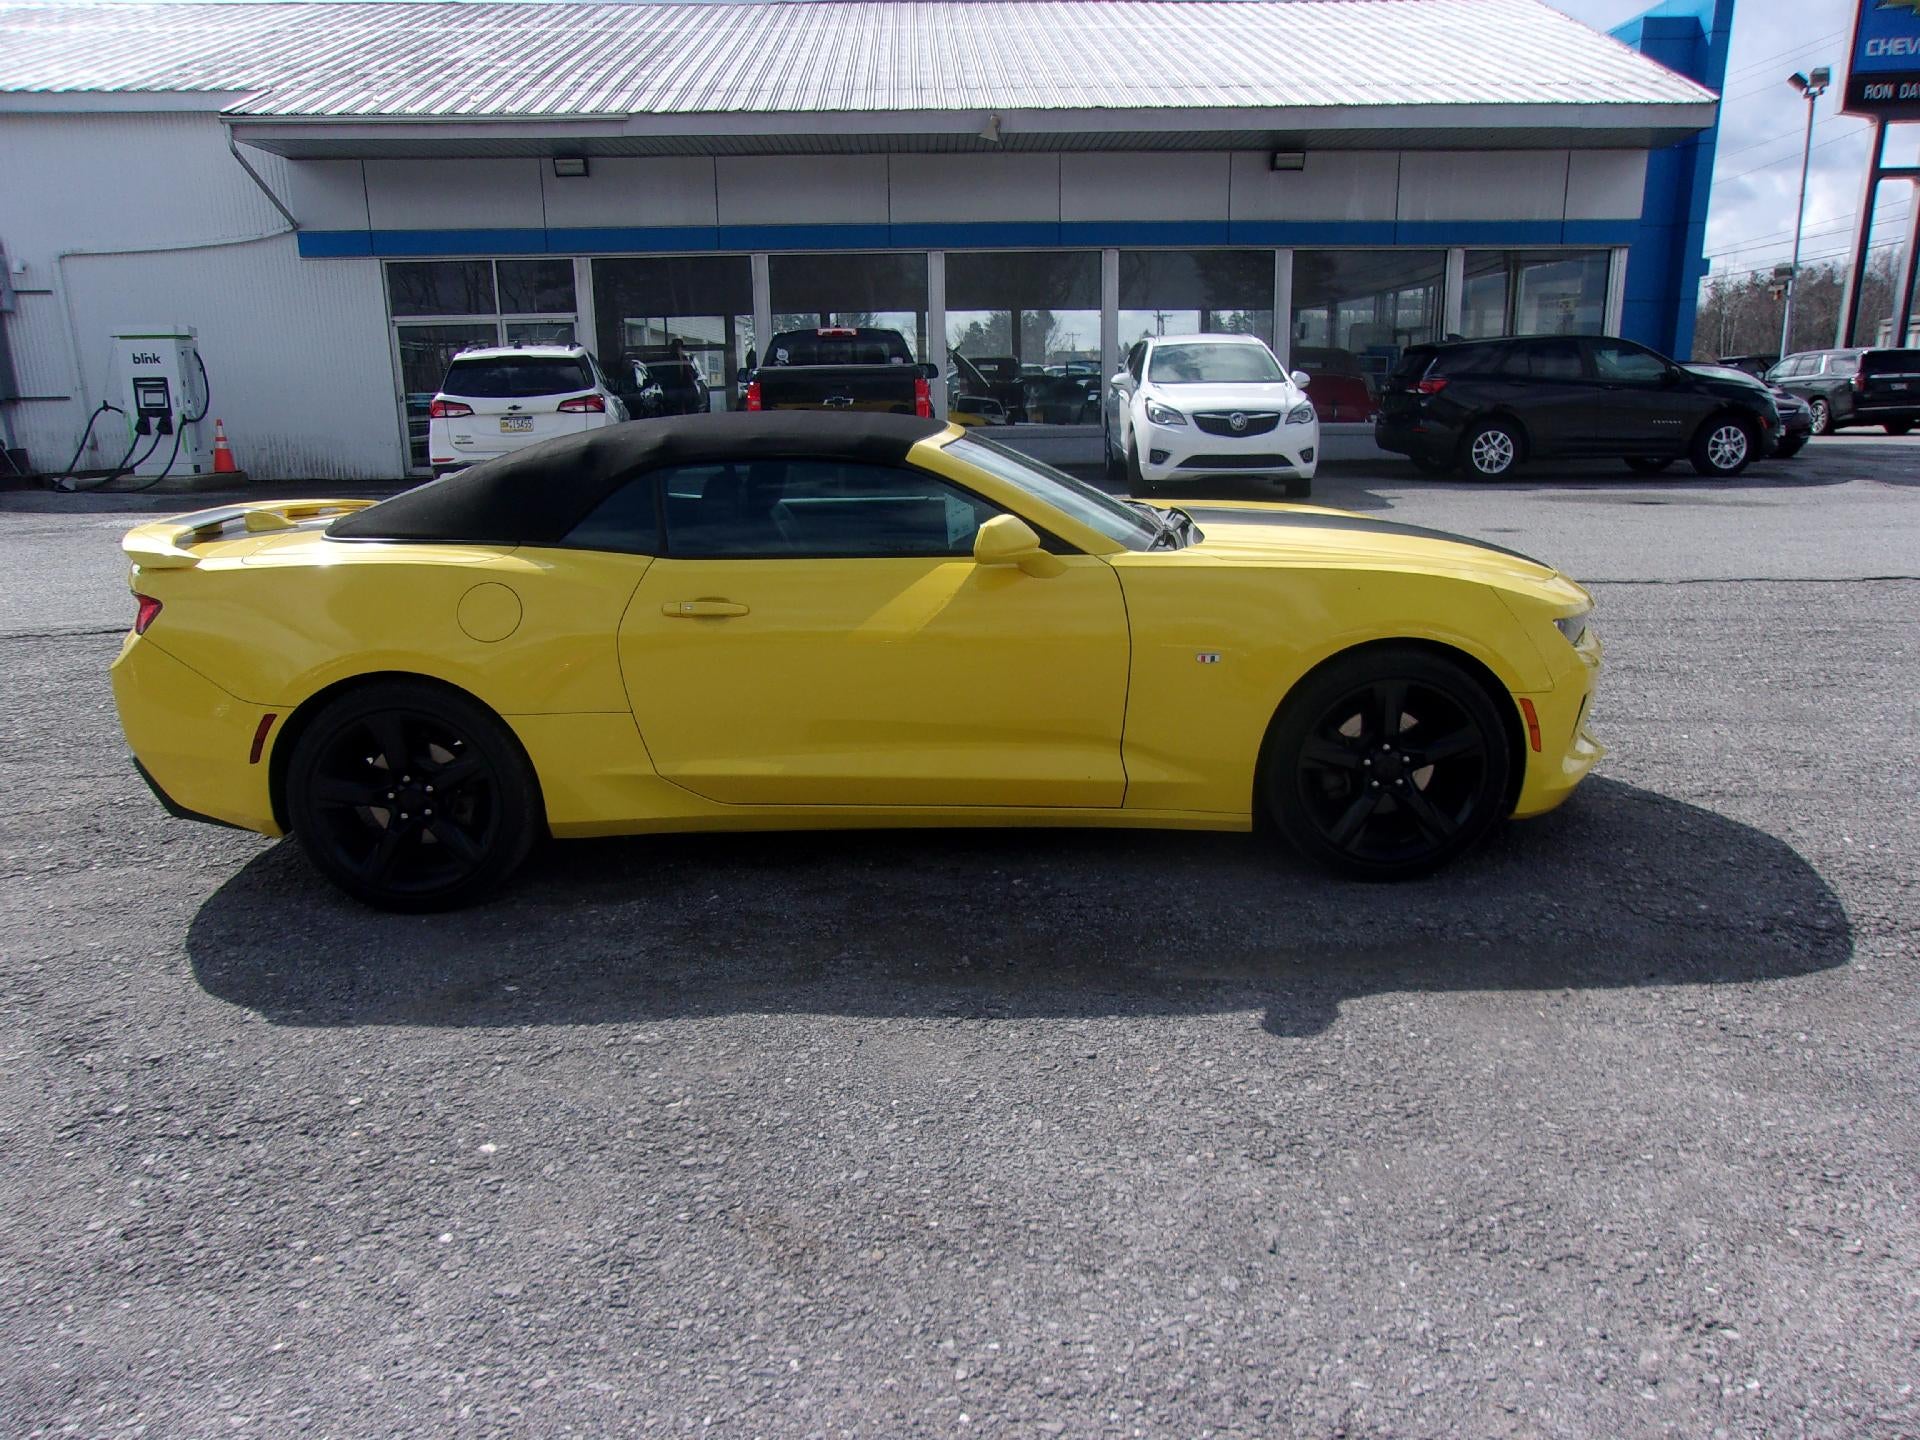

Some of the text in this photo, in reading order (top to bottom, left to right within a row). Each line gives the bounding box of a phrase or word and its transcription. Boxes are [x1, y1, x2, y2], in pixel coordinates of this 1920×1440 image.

[1864, 82, 1920, 99] RON DA
[132, 352, 161, 364] blink
